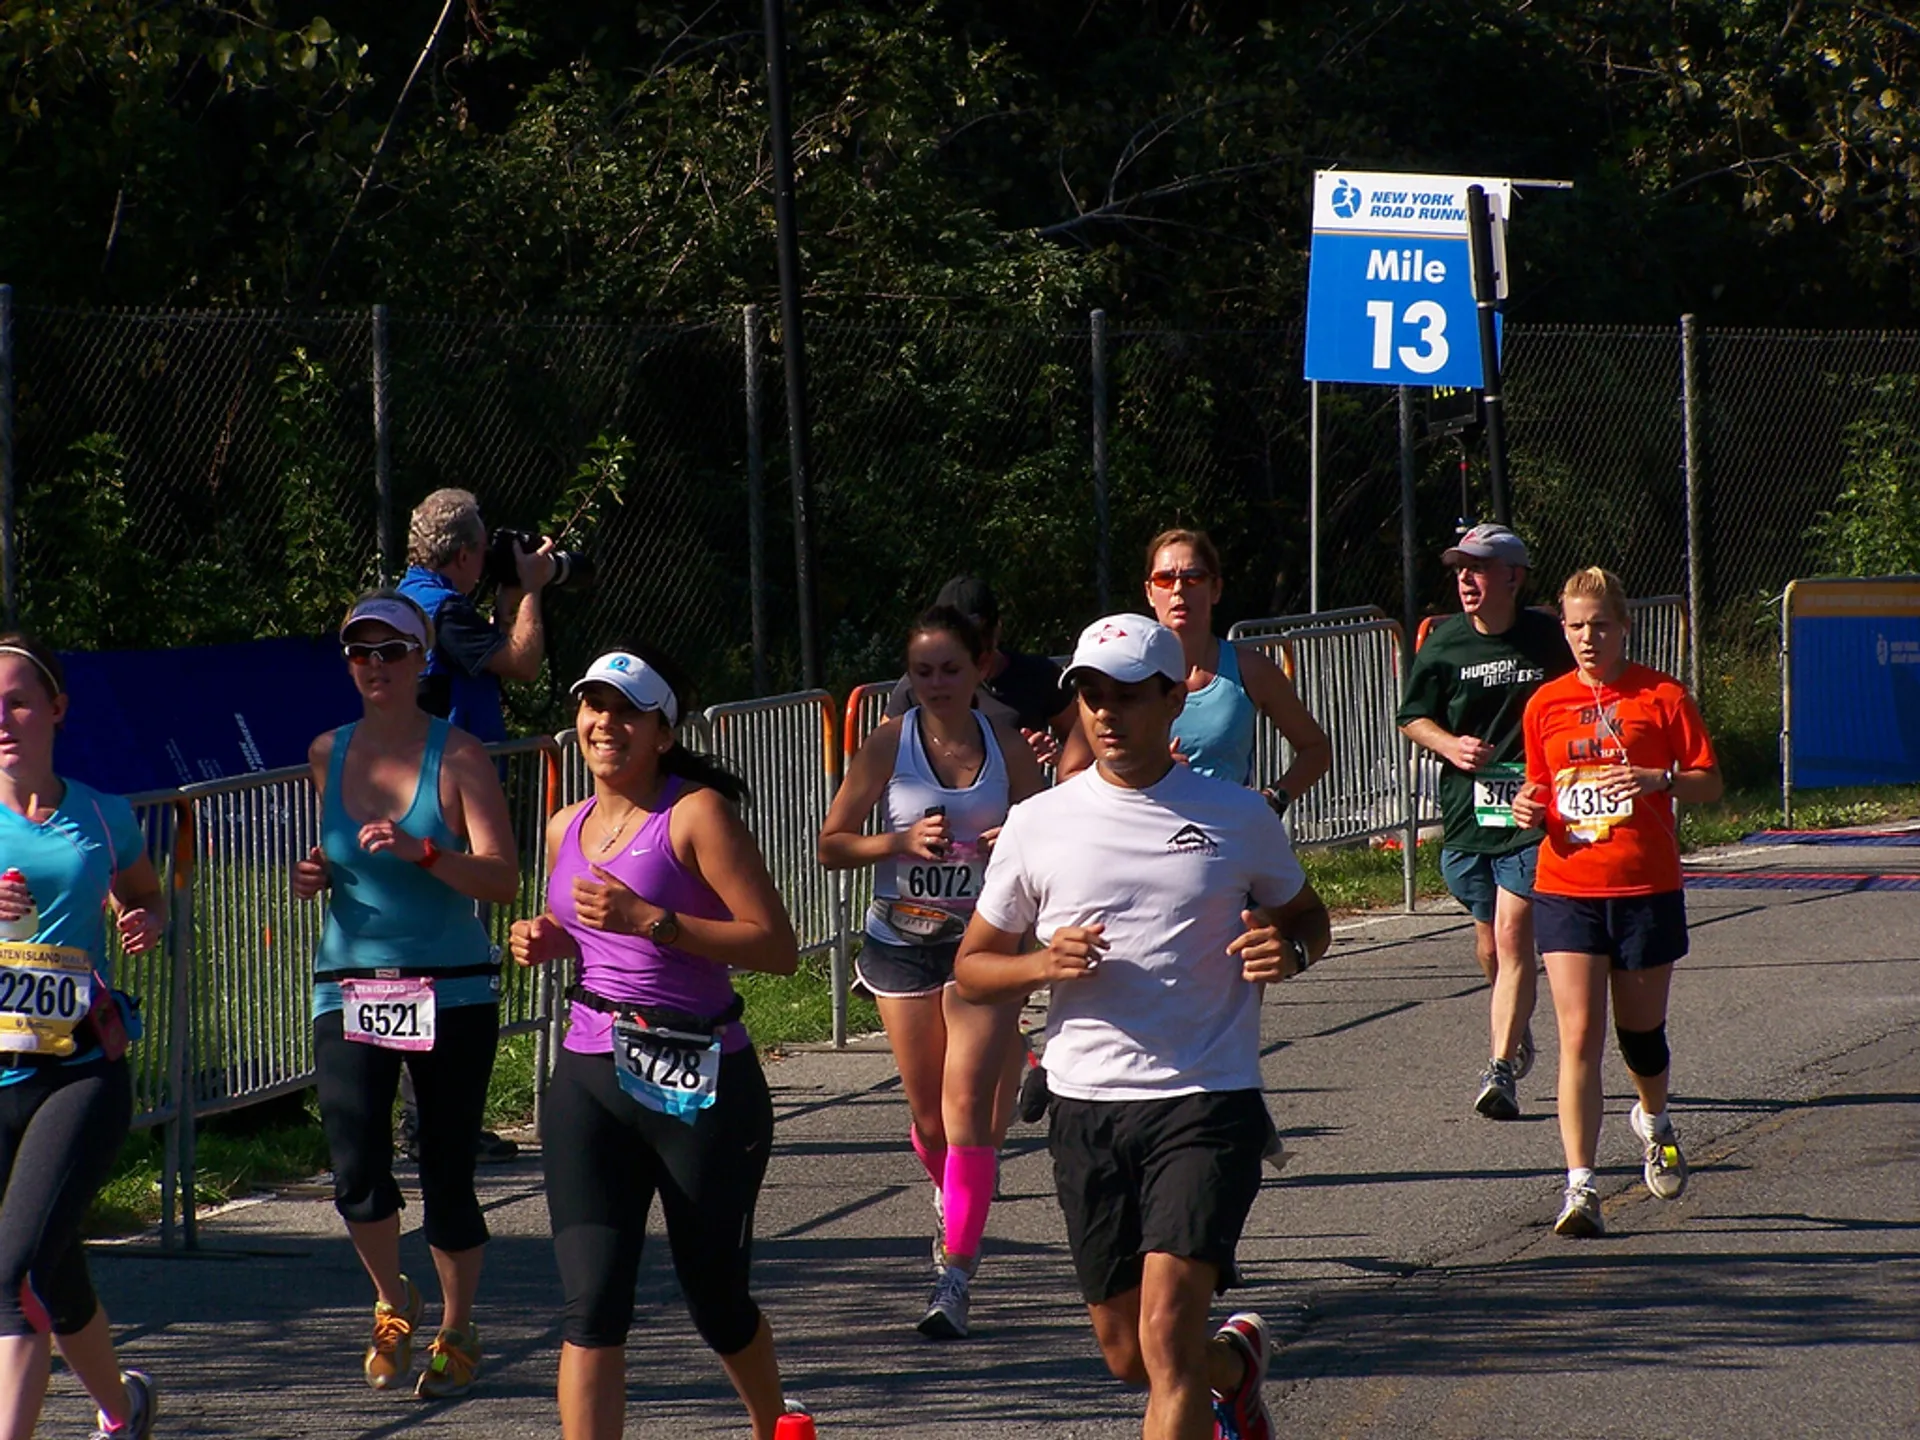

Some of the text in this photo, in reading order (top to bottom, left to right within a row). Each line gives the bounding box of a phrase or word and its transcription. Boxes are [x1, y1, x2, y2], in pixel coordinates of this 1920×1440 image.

[1370, 205, 1467, 221] ROAD RUNN
[1371, 191, 1454, 206] NEW YORK
[1366, 249, 1446, 284] Mile
[1366, 300, 1450, 374] 13
[1460, 659, 1517, 680] HUDSON
[1482, 668, 1544, 687] DUSTERS
[909, 866, 971, 898] 6072
[22, 950, 60, 963] ISLAND
[0, 972, 77, 1018] 2260
[359, 1003, 420, 1037] 6521
[625, 1041, 701, 1090] 5728
